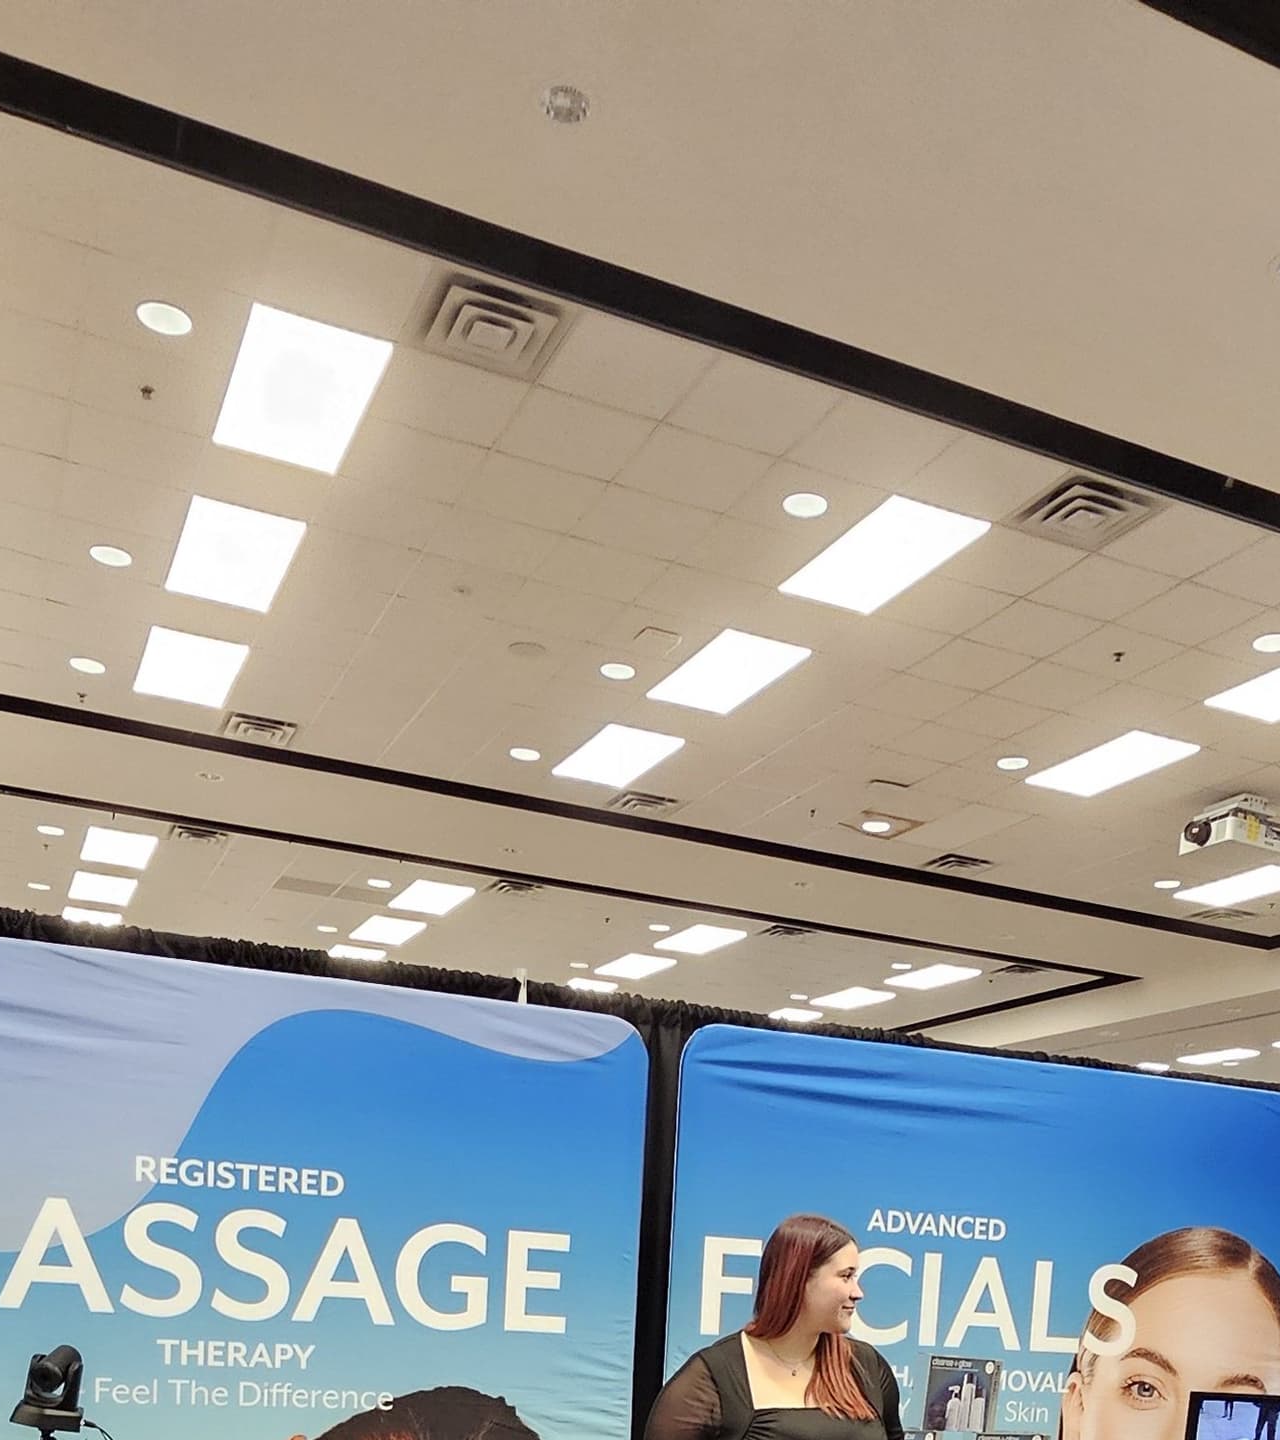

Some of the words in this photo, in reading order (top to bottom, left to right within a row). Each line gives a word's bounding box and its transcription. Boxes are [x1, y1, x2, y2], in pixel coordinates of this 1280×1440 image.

[134, 1154, 346, 1197] REGISTERED
[867, 1208, 1007, 1242] ADVANCED
[699, 1235, 1139, 1357] FCIALS
[156, 1338, 316, 1370] THERAPY
[94, 1377, 158, 1405] Feel
[168, 1378, 229, 1407] The
[238, 1380, 394, 1411] Difference
[1004, 1400, 1049, 1423] Skin
